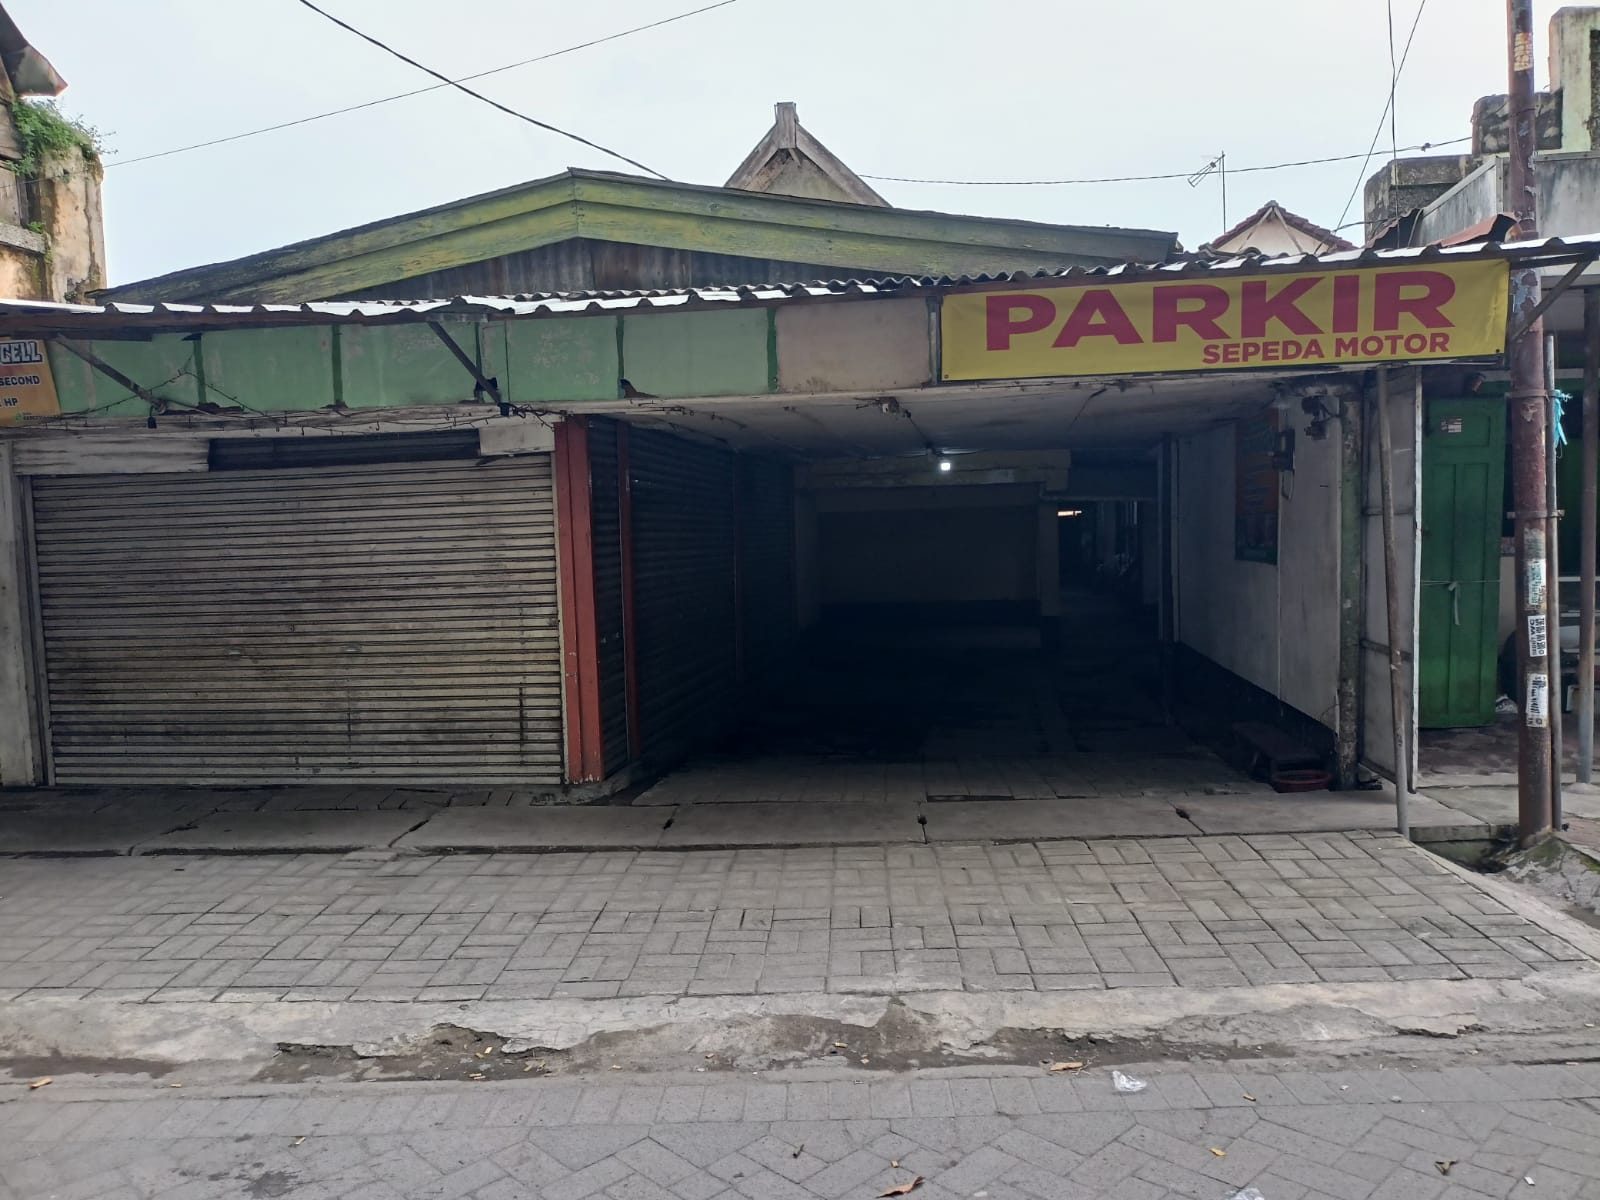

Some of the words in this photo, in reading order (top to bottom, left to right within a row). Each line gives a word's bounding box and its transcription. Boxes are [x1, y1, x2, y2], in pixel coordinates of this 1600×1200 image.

[986, 270, 1457, 351] PARKIR
[0, 341, 42, 363] CELL
[1202, 338, 1325, 364] SEPEDA
[1335, 333, 1450, 358] MOTOR
[0, 376, 40, 386] SECOND
[4, 398, 18, 407] HP
